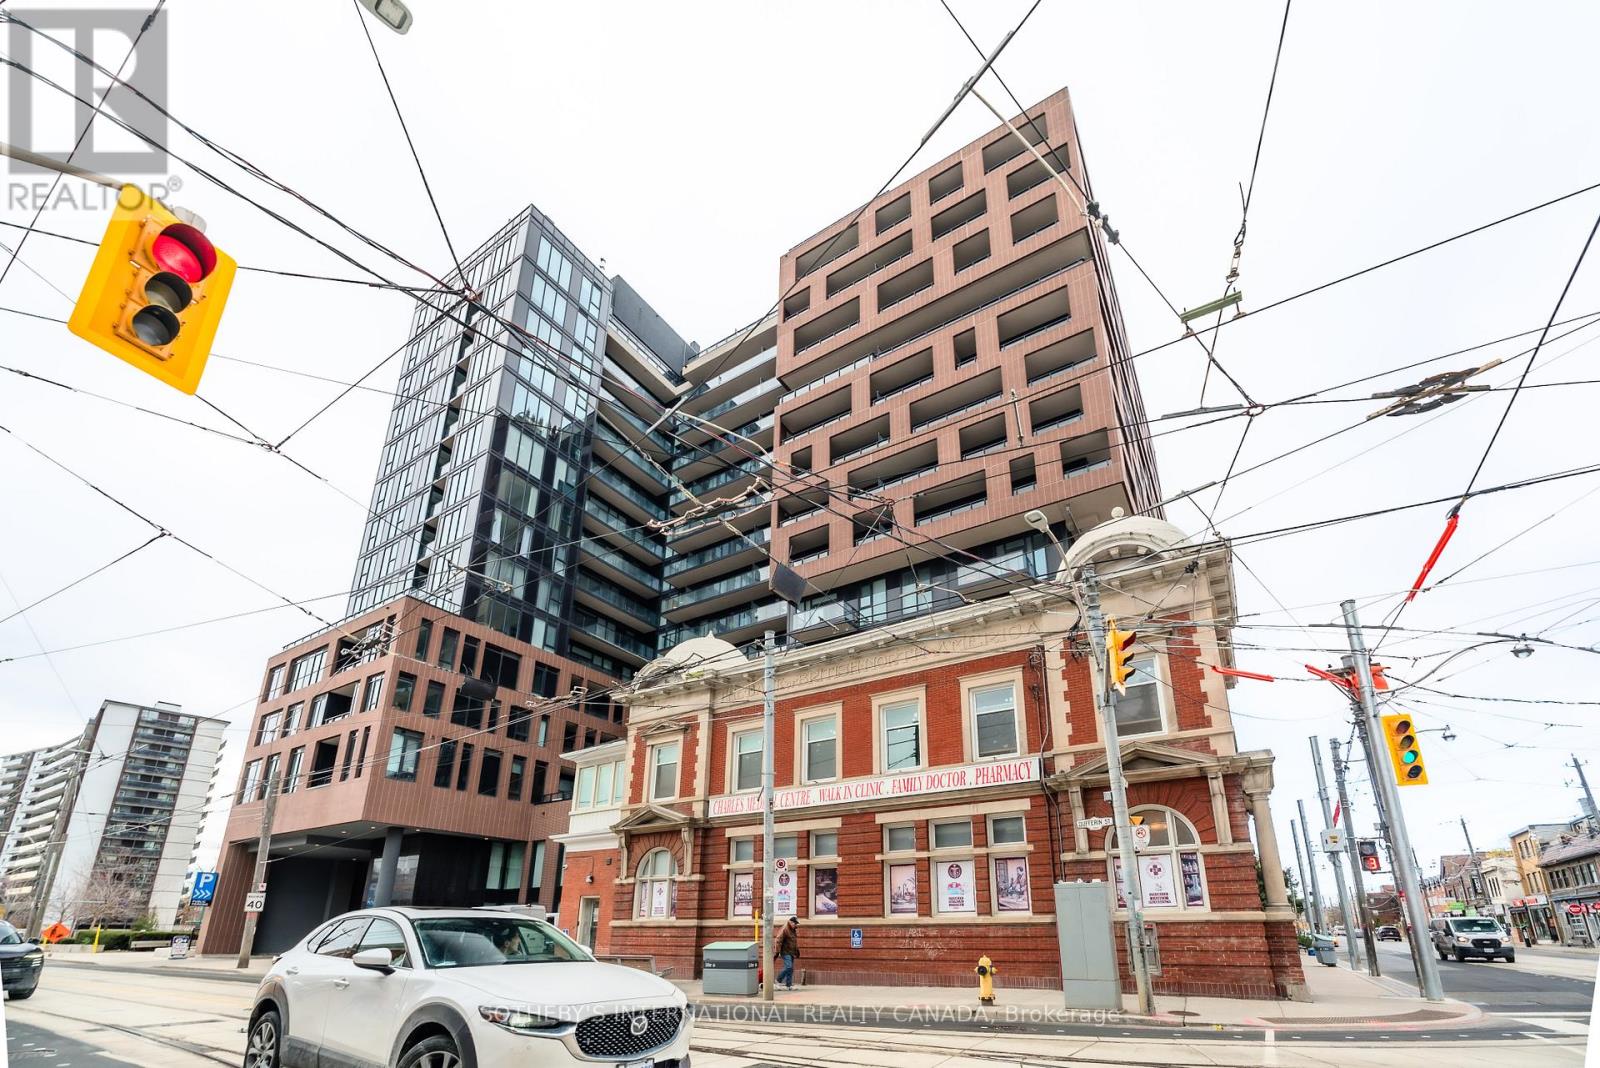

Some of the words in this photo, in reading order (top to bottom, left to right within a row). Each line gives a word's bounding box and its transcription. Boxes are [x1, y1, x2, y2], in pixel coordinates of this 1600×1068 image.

[938, 621, 1040, 649] AMERICA
[713, 797, 744, 815] CHARLES
[780, 789, 811, 807] CENTRE
[819, 786, 841, 802] WALK
[843, 784, 854, 799] IN
[855, 780, 885, 798] CLINIC
[892, 776, 922, 795] FAMILY
[926, 770, 966, 790] DOCTOR
[975, 761, 1032, 785] PHARMACY
[1078, 819, 1102, 827] DUFFERIN
[199, 873, 214, 888] P
[247, 900, 263, 909] 40
